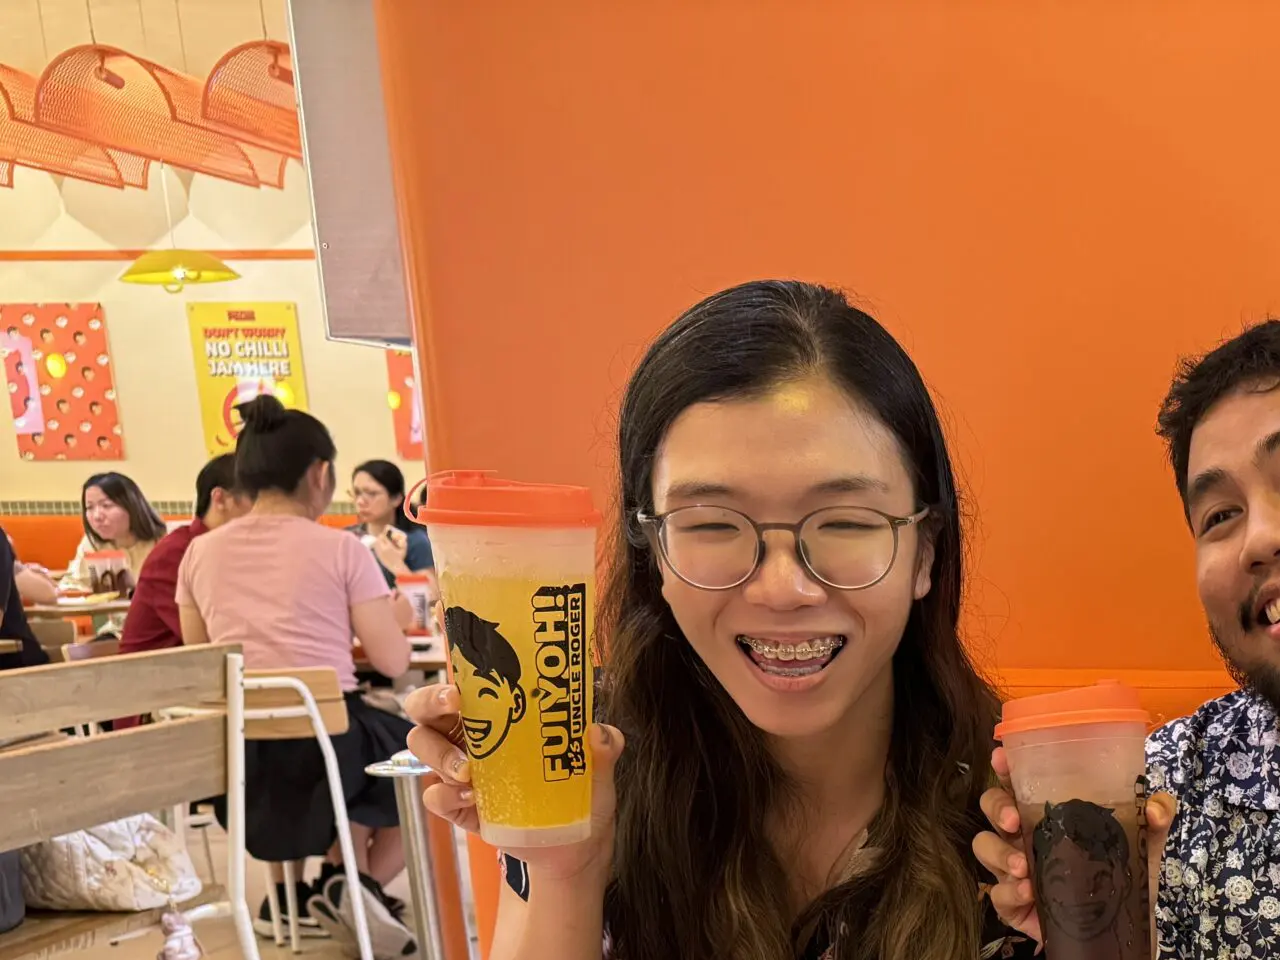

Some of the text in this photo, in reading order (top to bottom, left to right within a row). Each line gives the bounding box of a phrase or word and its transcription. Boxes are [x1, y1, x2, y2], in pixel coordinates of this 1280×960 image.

[205, 340, 290, 358] NO CHILLI
[208, 361, 291, 377] JAM HERE
[569, 596, 582, 667] ROGER
[531, 590, 571, 783] FUIYOH!
[571, 670, 583, 734] UNCLE
